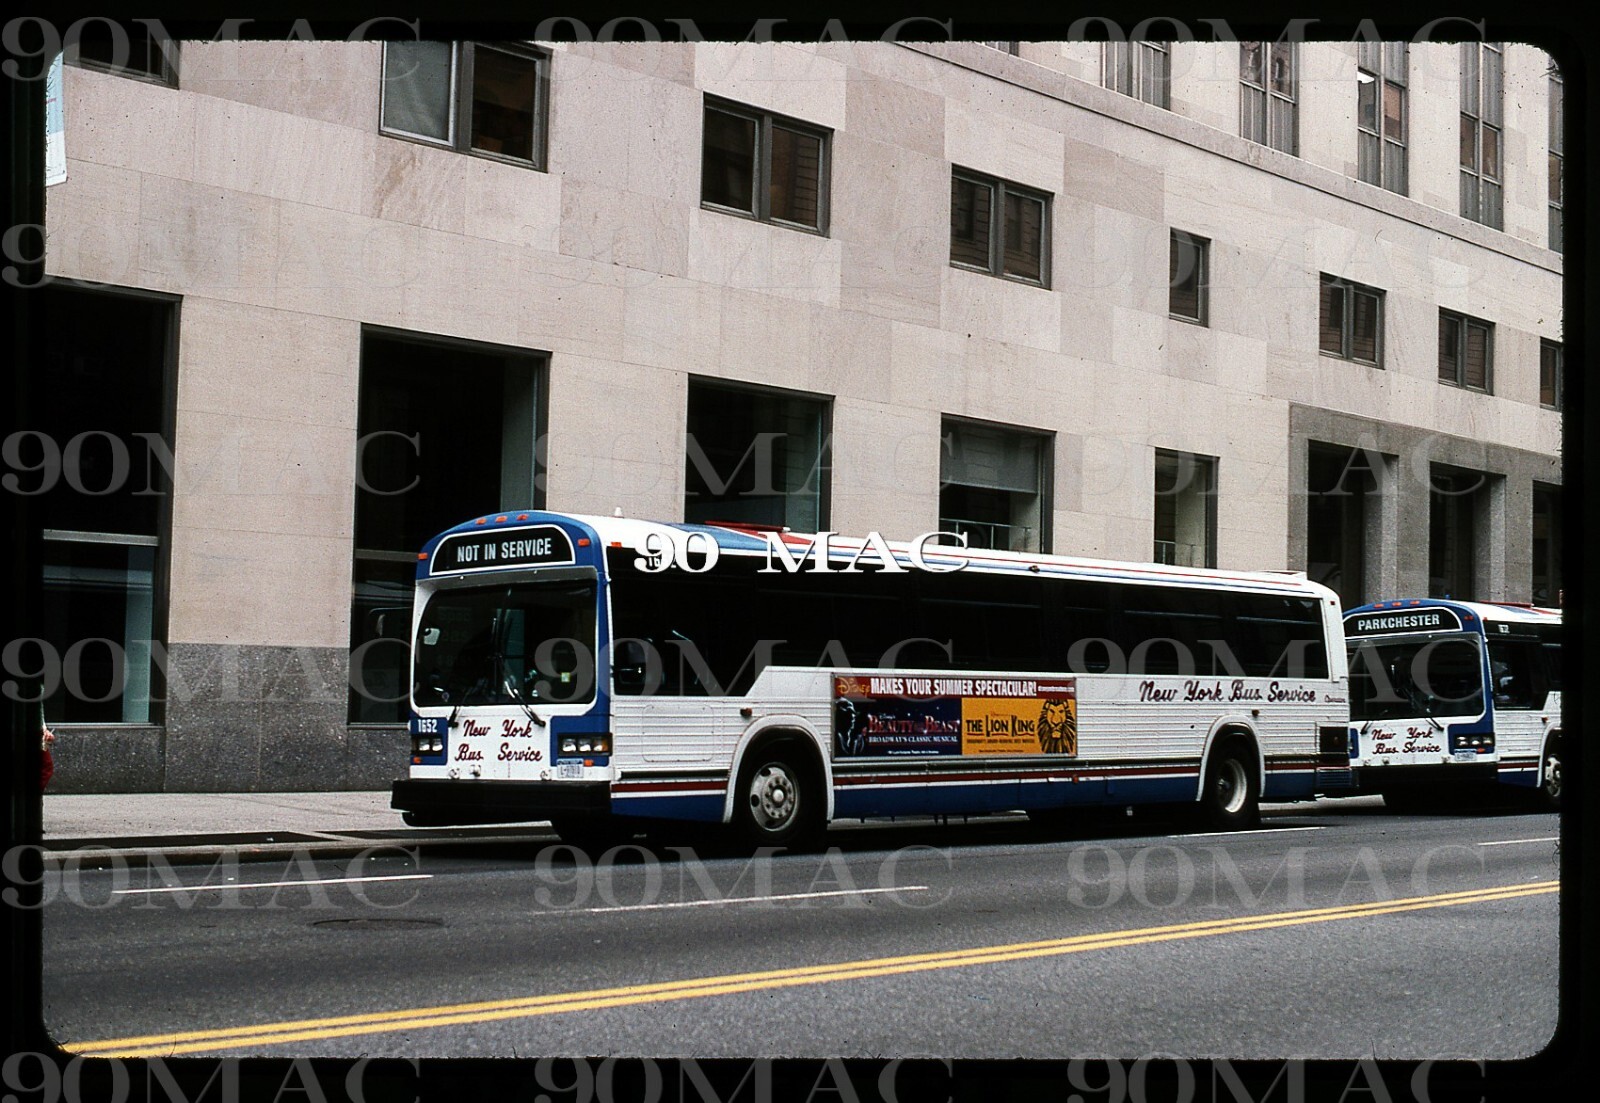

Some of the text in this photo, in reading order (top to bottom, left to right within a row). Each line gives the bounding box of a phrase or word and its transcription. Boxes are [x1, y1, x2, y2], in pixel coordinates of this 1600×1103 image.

[457, 538, 552, 562] NOT IN SERVICE
[1358, 614, 1440, 631] PARKCHESTER
[870, 678, 904, 695] MAKES
[905, 678, 932, 695] YOUR
[933, 679, 974, 696] SUMMER
[975, 679, 1037, 697] SPECTACULAR!
[1139, 680, 1178, 702] New
[1183, 680, 1223, 702] York
[1228, 679, 1262, 702] Bus
[1268, 681, 1316, 702] Service
[417, 719, 438, 733] 1652
[463, 719, 533, 737] New York
[966, 715, 1035, 737] THE LION KING
[1371, 727, 1434, 740] New York
[455, 742, 543, 762] Bus Service
[1372, 741, 1441, 754] Bus Service
